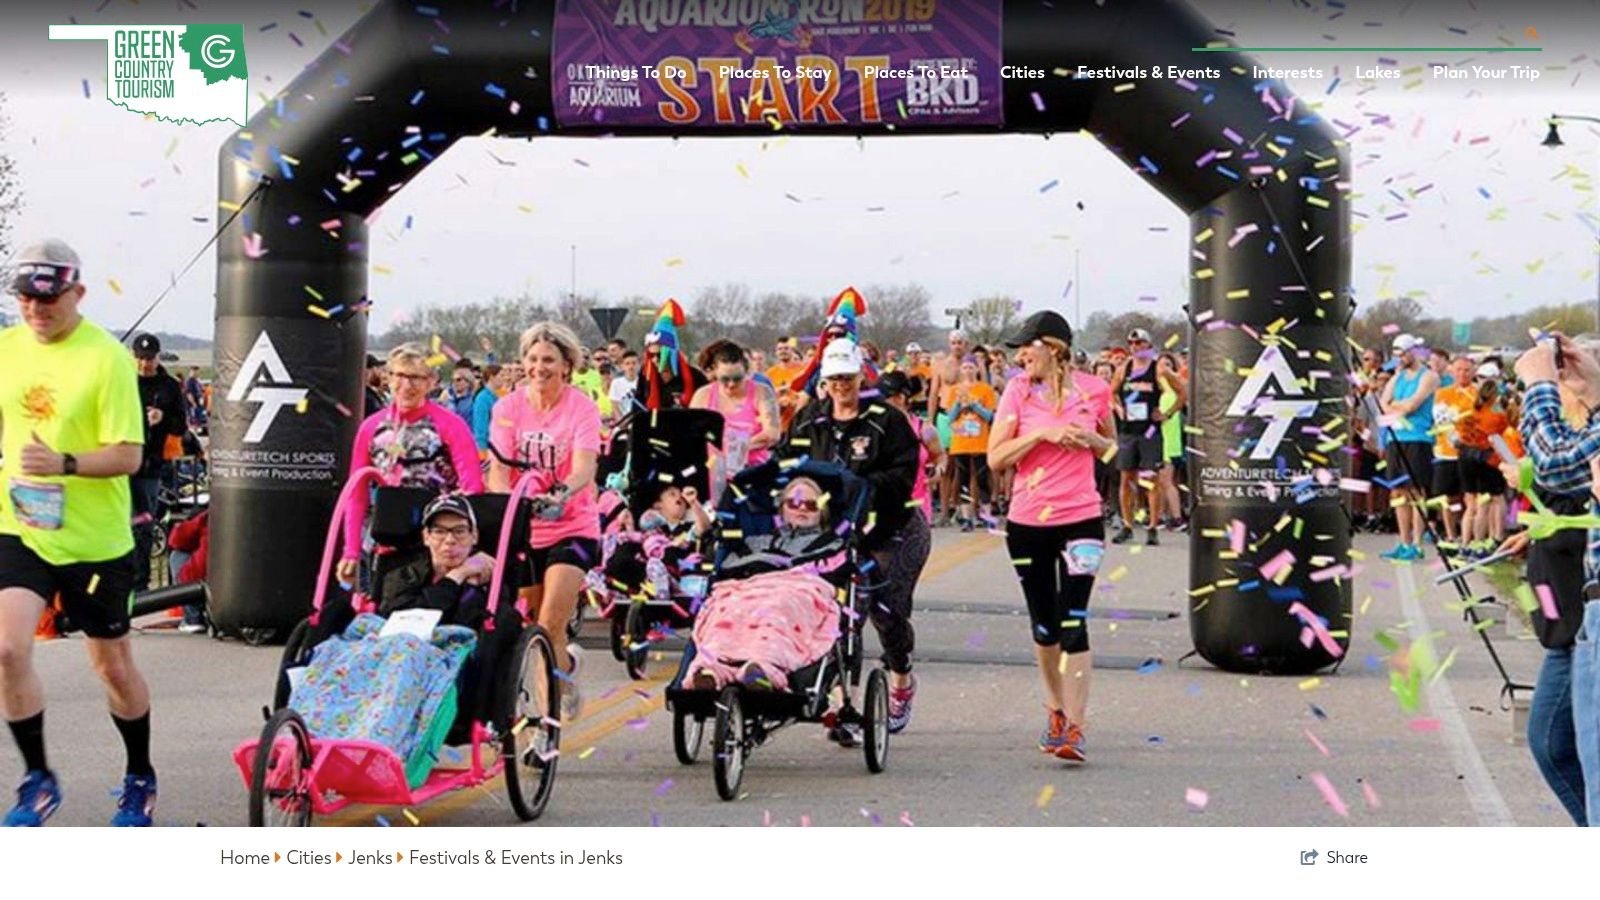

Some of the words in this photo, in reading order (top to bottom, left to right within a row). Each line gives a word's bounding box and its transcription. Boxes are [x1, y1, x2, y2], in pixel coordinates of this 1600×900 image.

[614, 0, 789, 33] AQUARIUM
[569, 86, 642, 108] AQUARIUM
[656, 54, 890, 124] START
[906, 74, 980, 106] BKD
[271, 468, 332, 480] Production
[1235, 487, 1244, 497] &
[1247, 486, 1281, 498] Evet
